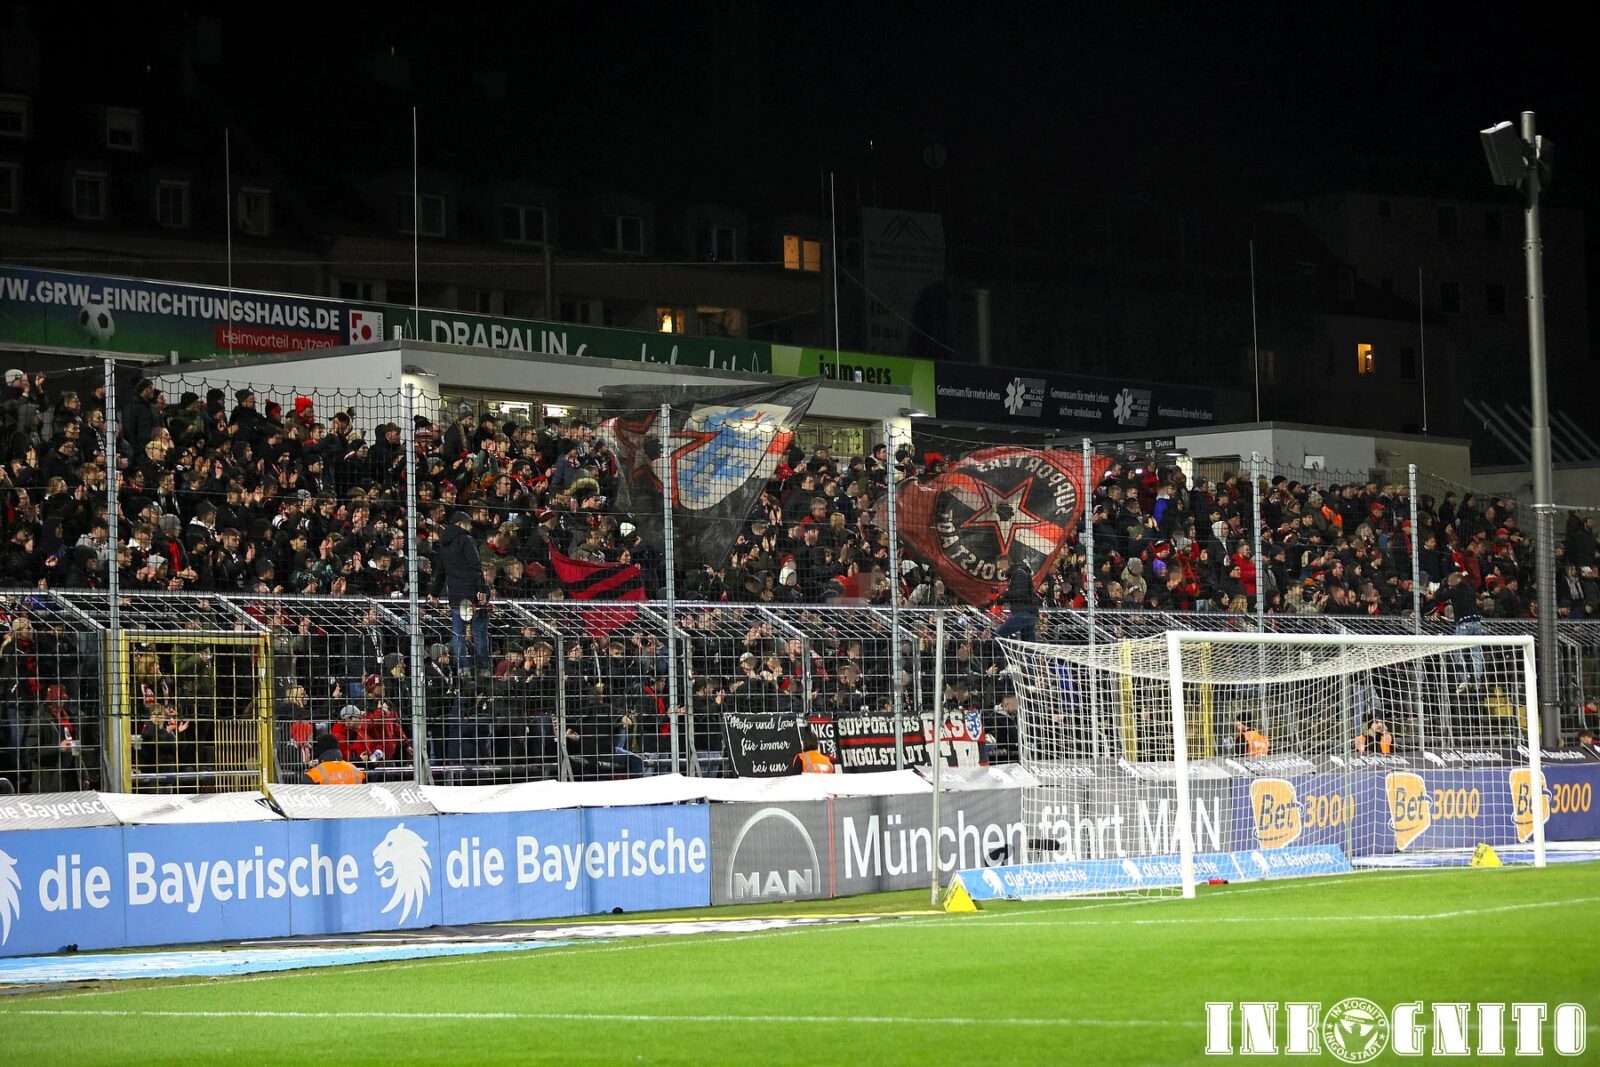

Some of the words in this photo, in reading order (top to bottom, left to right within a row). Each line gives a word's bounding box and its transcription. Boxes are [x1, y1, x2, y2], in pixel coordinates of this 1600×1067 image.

[222, 329, 289, 349] Heimvorteil
[937, 384, 964, 398] Gemeinsam
[973, 388, 985, 400] mehr
[986, 389, 1001, 401] Leben
[1050, 387, 1076, 400] Gemeinsam
[741, 737, 758, 757] für
[760, 740, 790, 752] immer
[769, 762, 789, 773] uns
[1304, 794, 1356, 829] 3000
[1431, 787, 1480, 820] 3000
[1551, 782, 1592, 815] 3000
[843, 809, 1027, 880] München
[1038, 803, 1126, 864] fährt
[446, 836, 504, 889] die
[516, 826, 706, 891] Bayerische
[38, 854, 111, 912] die
[128, 843, 359, 914] Bayerische
[733, 868, 812, 899] MAN
